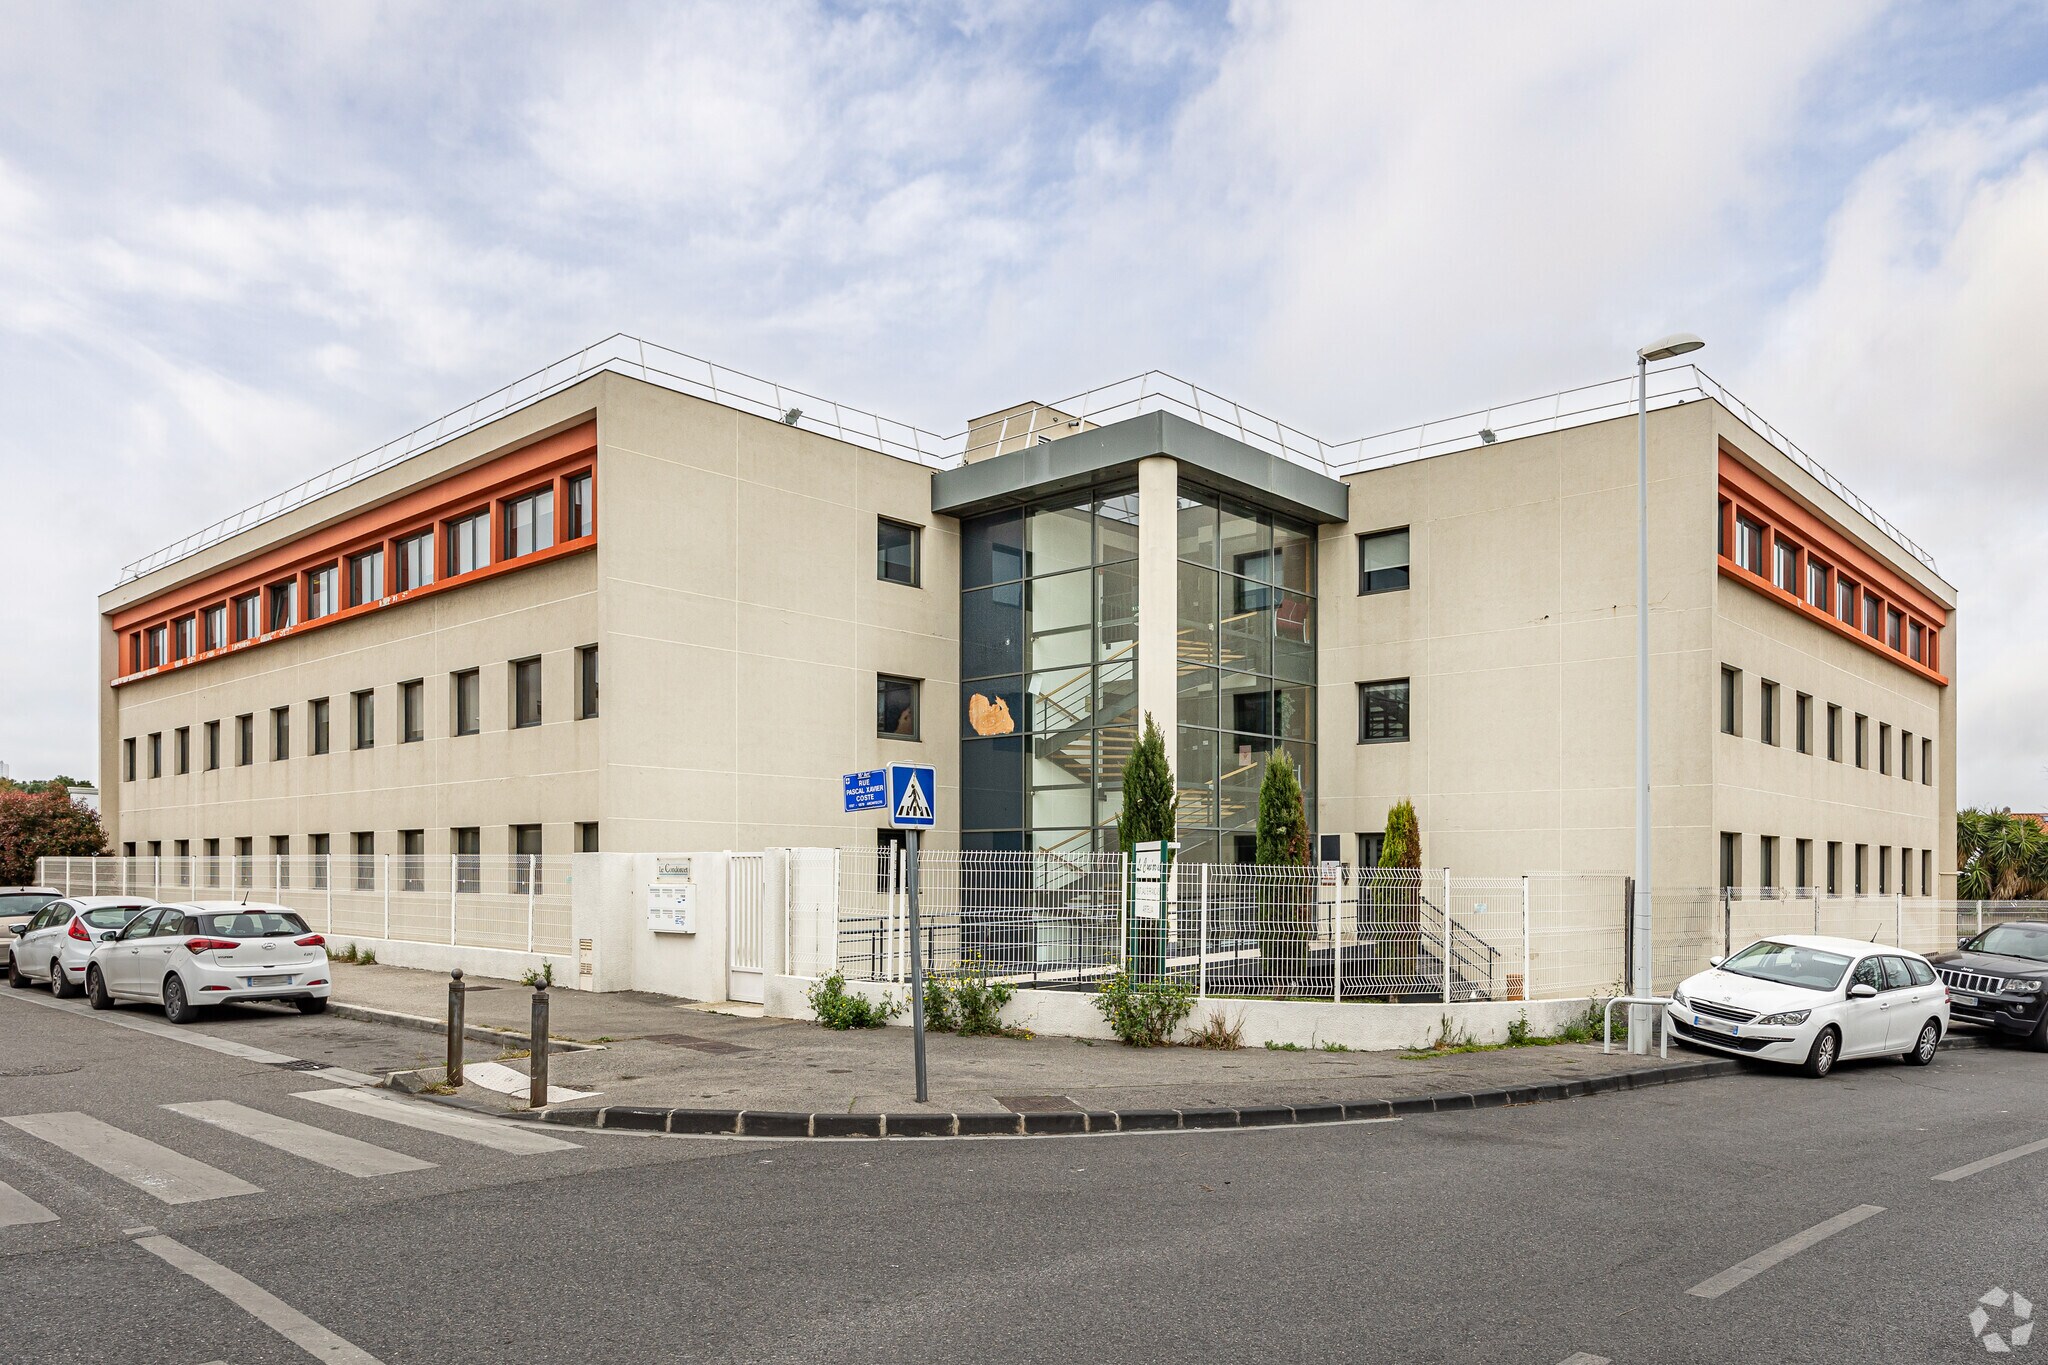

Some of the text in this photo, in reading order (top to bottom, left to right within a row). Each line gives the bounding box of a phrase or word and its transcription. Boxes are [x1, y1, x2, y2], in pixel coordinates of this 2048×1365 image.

[859, 779, 870, 787] RUE
[846, 784, 884, 796] PASCAL XAVIER
[856, 793, 875, 802] COSTE
[664, 863, 688, 873] Condorcet
